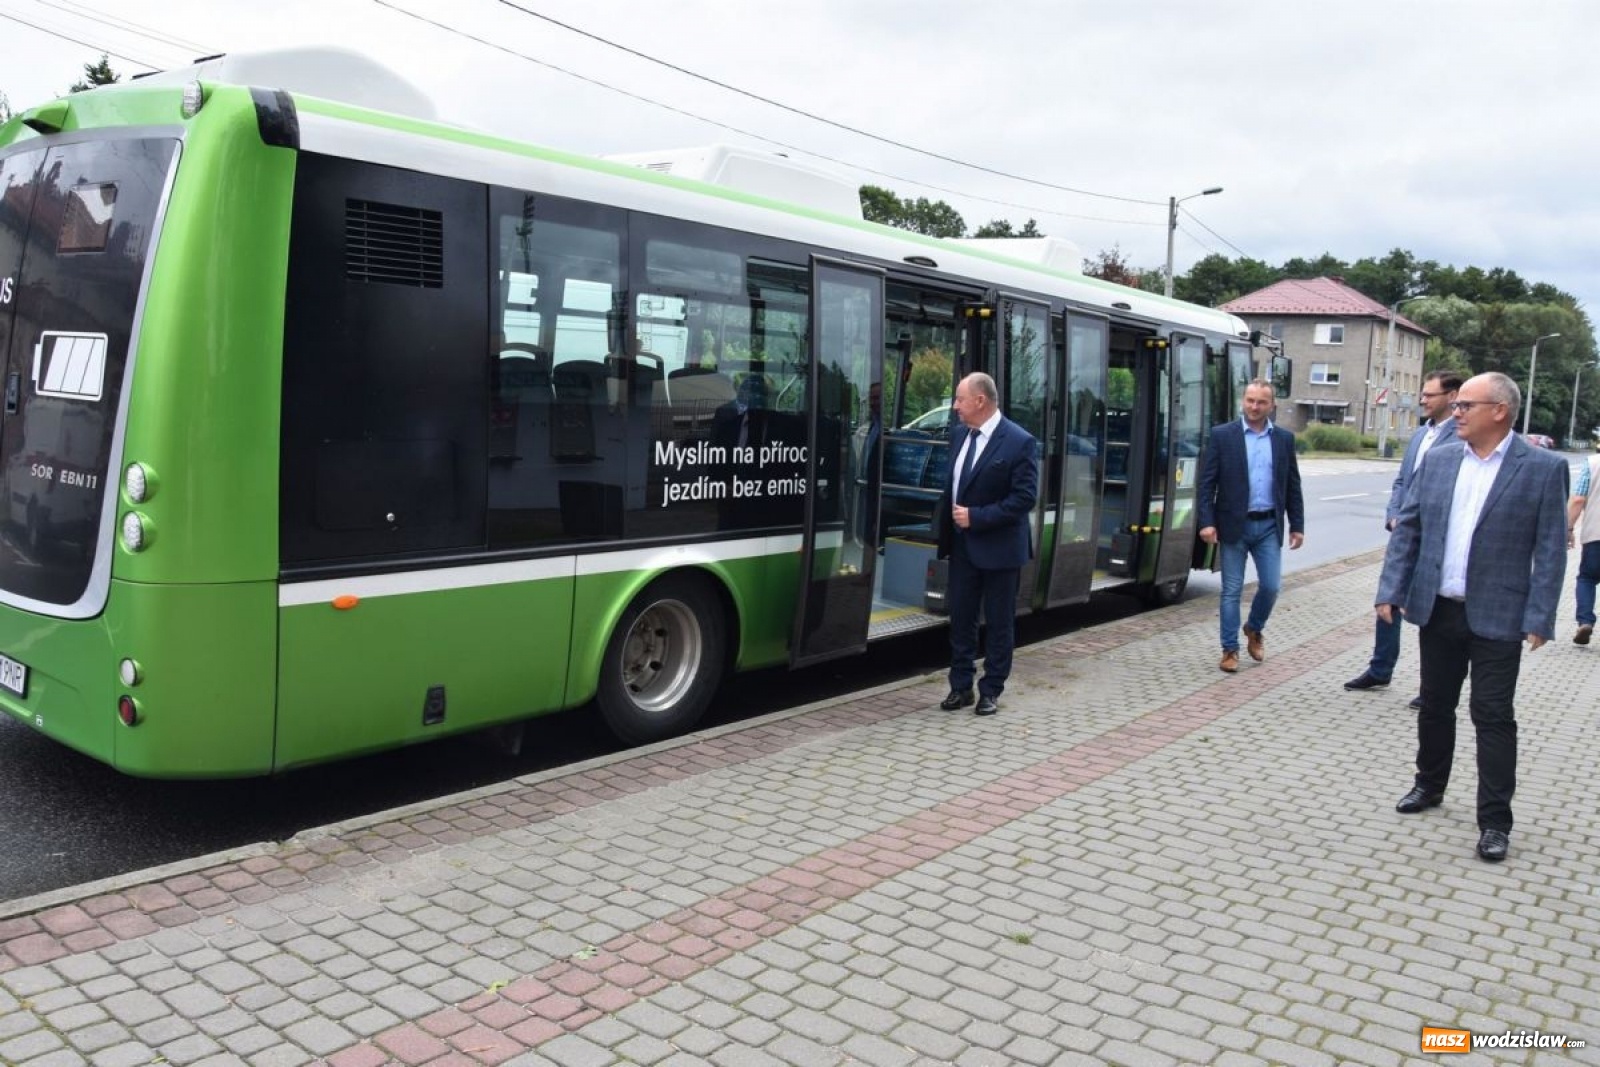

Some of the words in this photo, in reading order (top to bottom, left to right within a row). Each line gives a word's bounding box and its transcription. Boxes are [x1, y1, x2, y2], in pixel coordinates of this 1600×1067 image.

[655, 440, 726, 471] Myslím
[733, 446, 753, 464] na
[31, 463, 53, 480] SOR
[661, 475, 726, 507] jezdím
[733, 474, 762, 498] bez
[767, 472, 807, 496] emis
